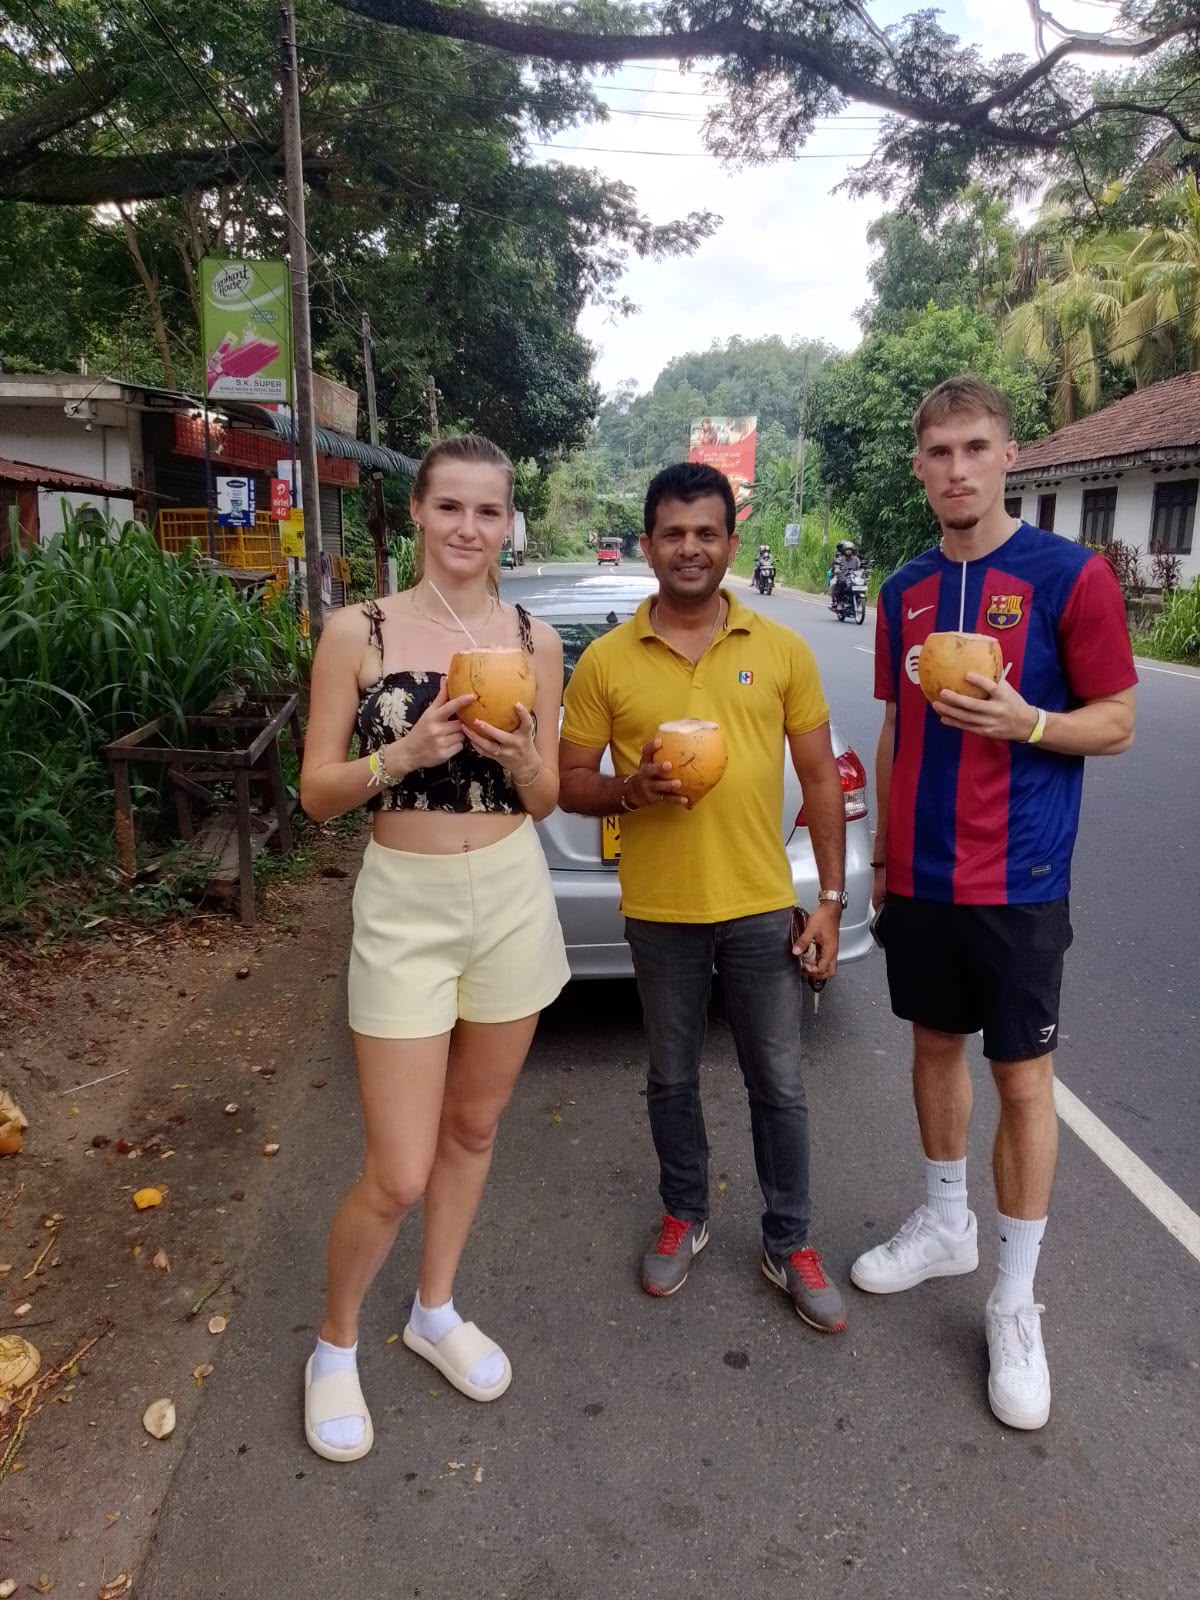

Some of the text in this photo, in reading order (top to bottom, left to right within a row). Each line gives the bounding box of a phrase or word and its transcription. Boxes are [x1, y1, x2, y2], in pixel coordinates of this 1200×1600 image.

[219, 279, 242, 297] House
[254, 380, 282, 388] SUPER
[272, 498, 289, 507] airtel
[276, 508, 287, 517] 4G
